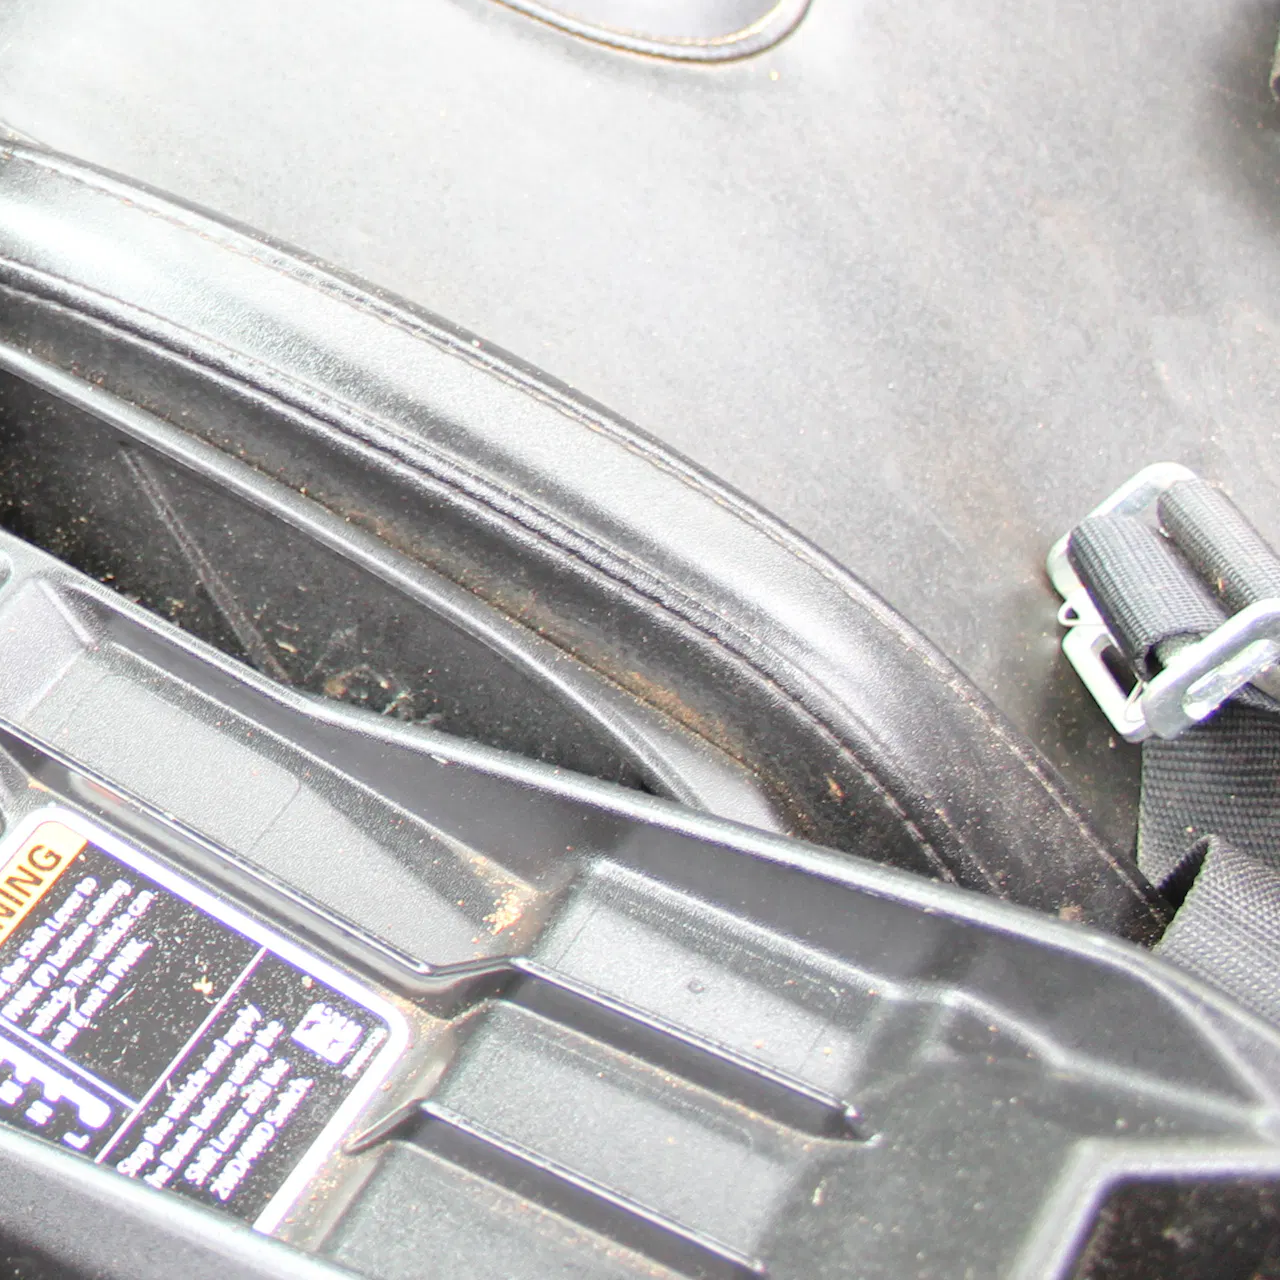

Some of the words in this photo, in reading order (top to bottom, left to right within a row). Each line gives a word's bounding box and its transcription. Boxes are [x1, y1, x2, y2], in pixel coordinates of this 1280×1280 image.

[0, 957, 29, 983] the
[75, 878, 96, 895] to
[1, 981, 42, 1021] PARK
[46, 923, 92, 968] before
[64, 958, 97, 985] The
[117, 1142, 154, 1178] Stop
[144, 1117, 173, 1144] the
[167, 1069, 210, 1119] vehicle
[203, 1039, 231, 1073] and
[224, 1003, 262, 1047] apply
[160, 1126, 202, 1169] Brake
[190, 1081, 237, 1129] before
[254, 1021, 283, 1047] the
[242, 1080, 271, 1114] and
[261, 1057, 289, 1085] the
